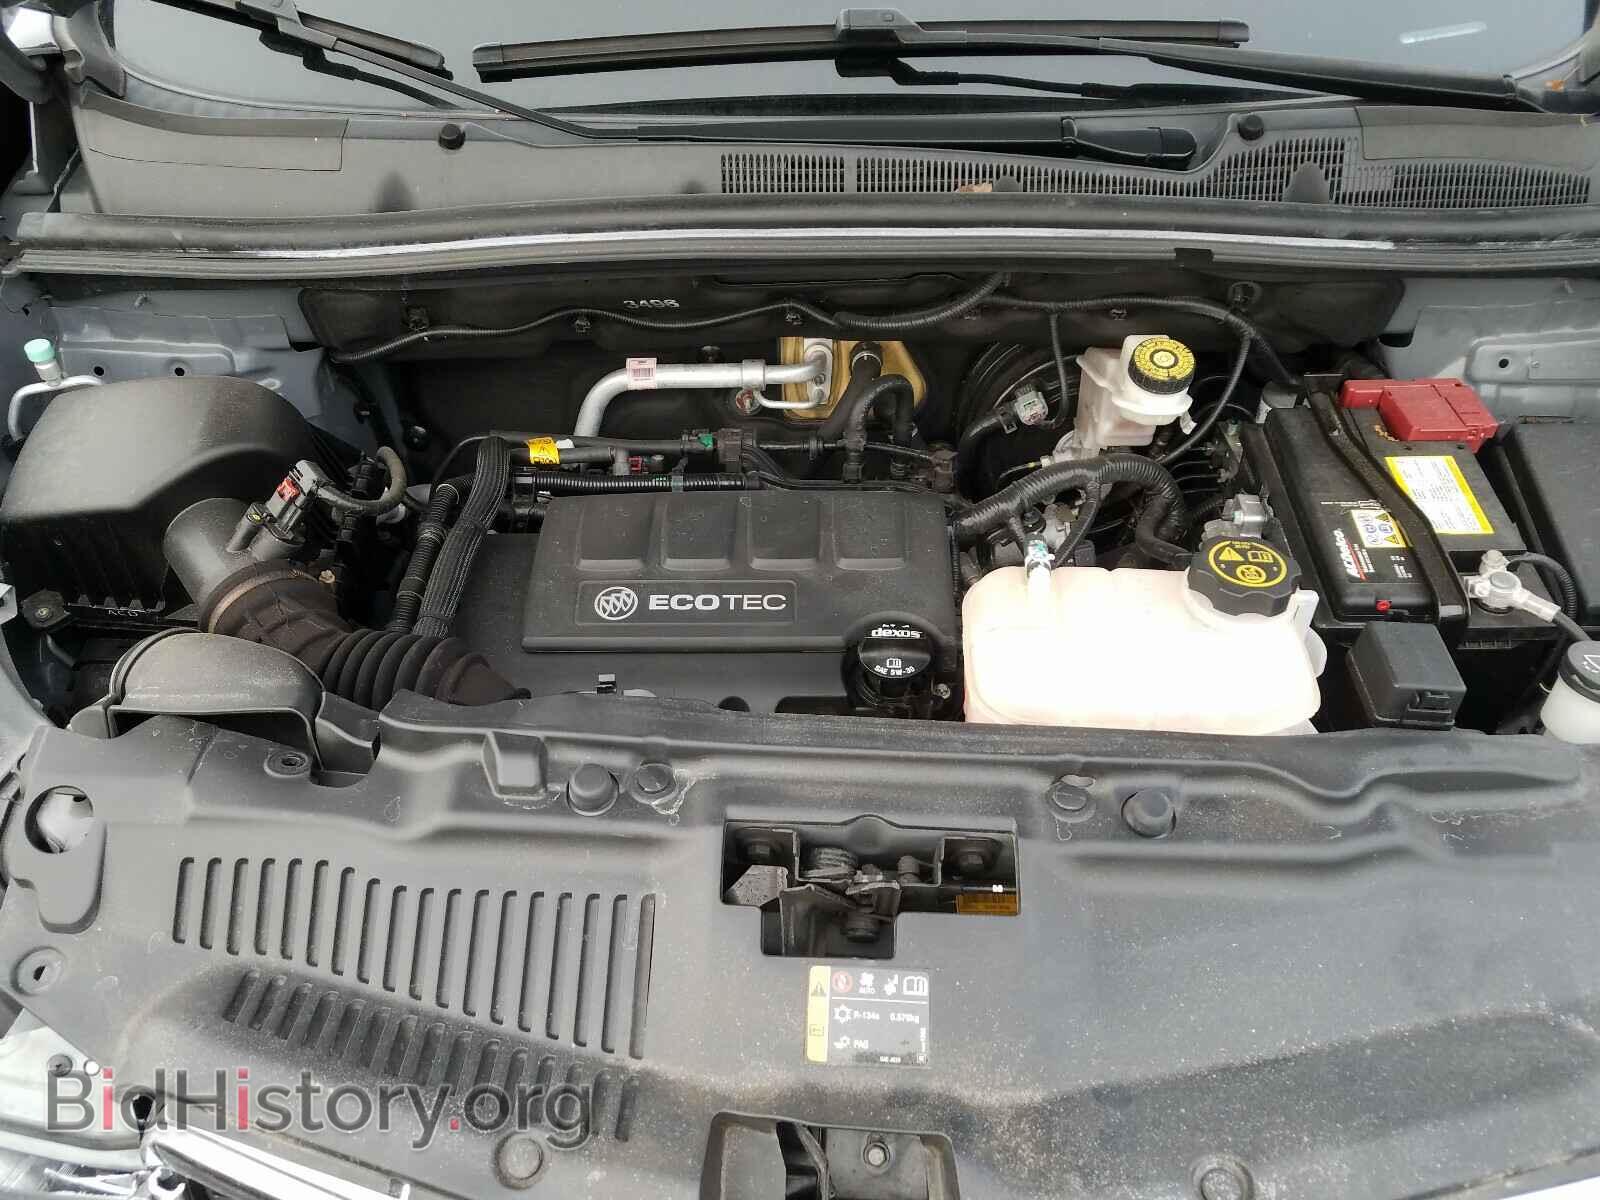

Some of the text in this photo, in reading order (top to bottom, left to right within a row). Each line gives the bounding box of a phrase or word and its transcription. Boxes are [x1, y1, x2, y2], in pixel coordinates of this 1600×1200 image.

[648, 594, 787, 611] ECOTEC
[871, 627, 923, 639] dexos
[874, 665, 916, 676] SAE 5W-30
